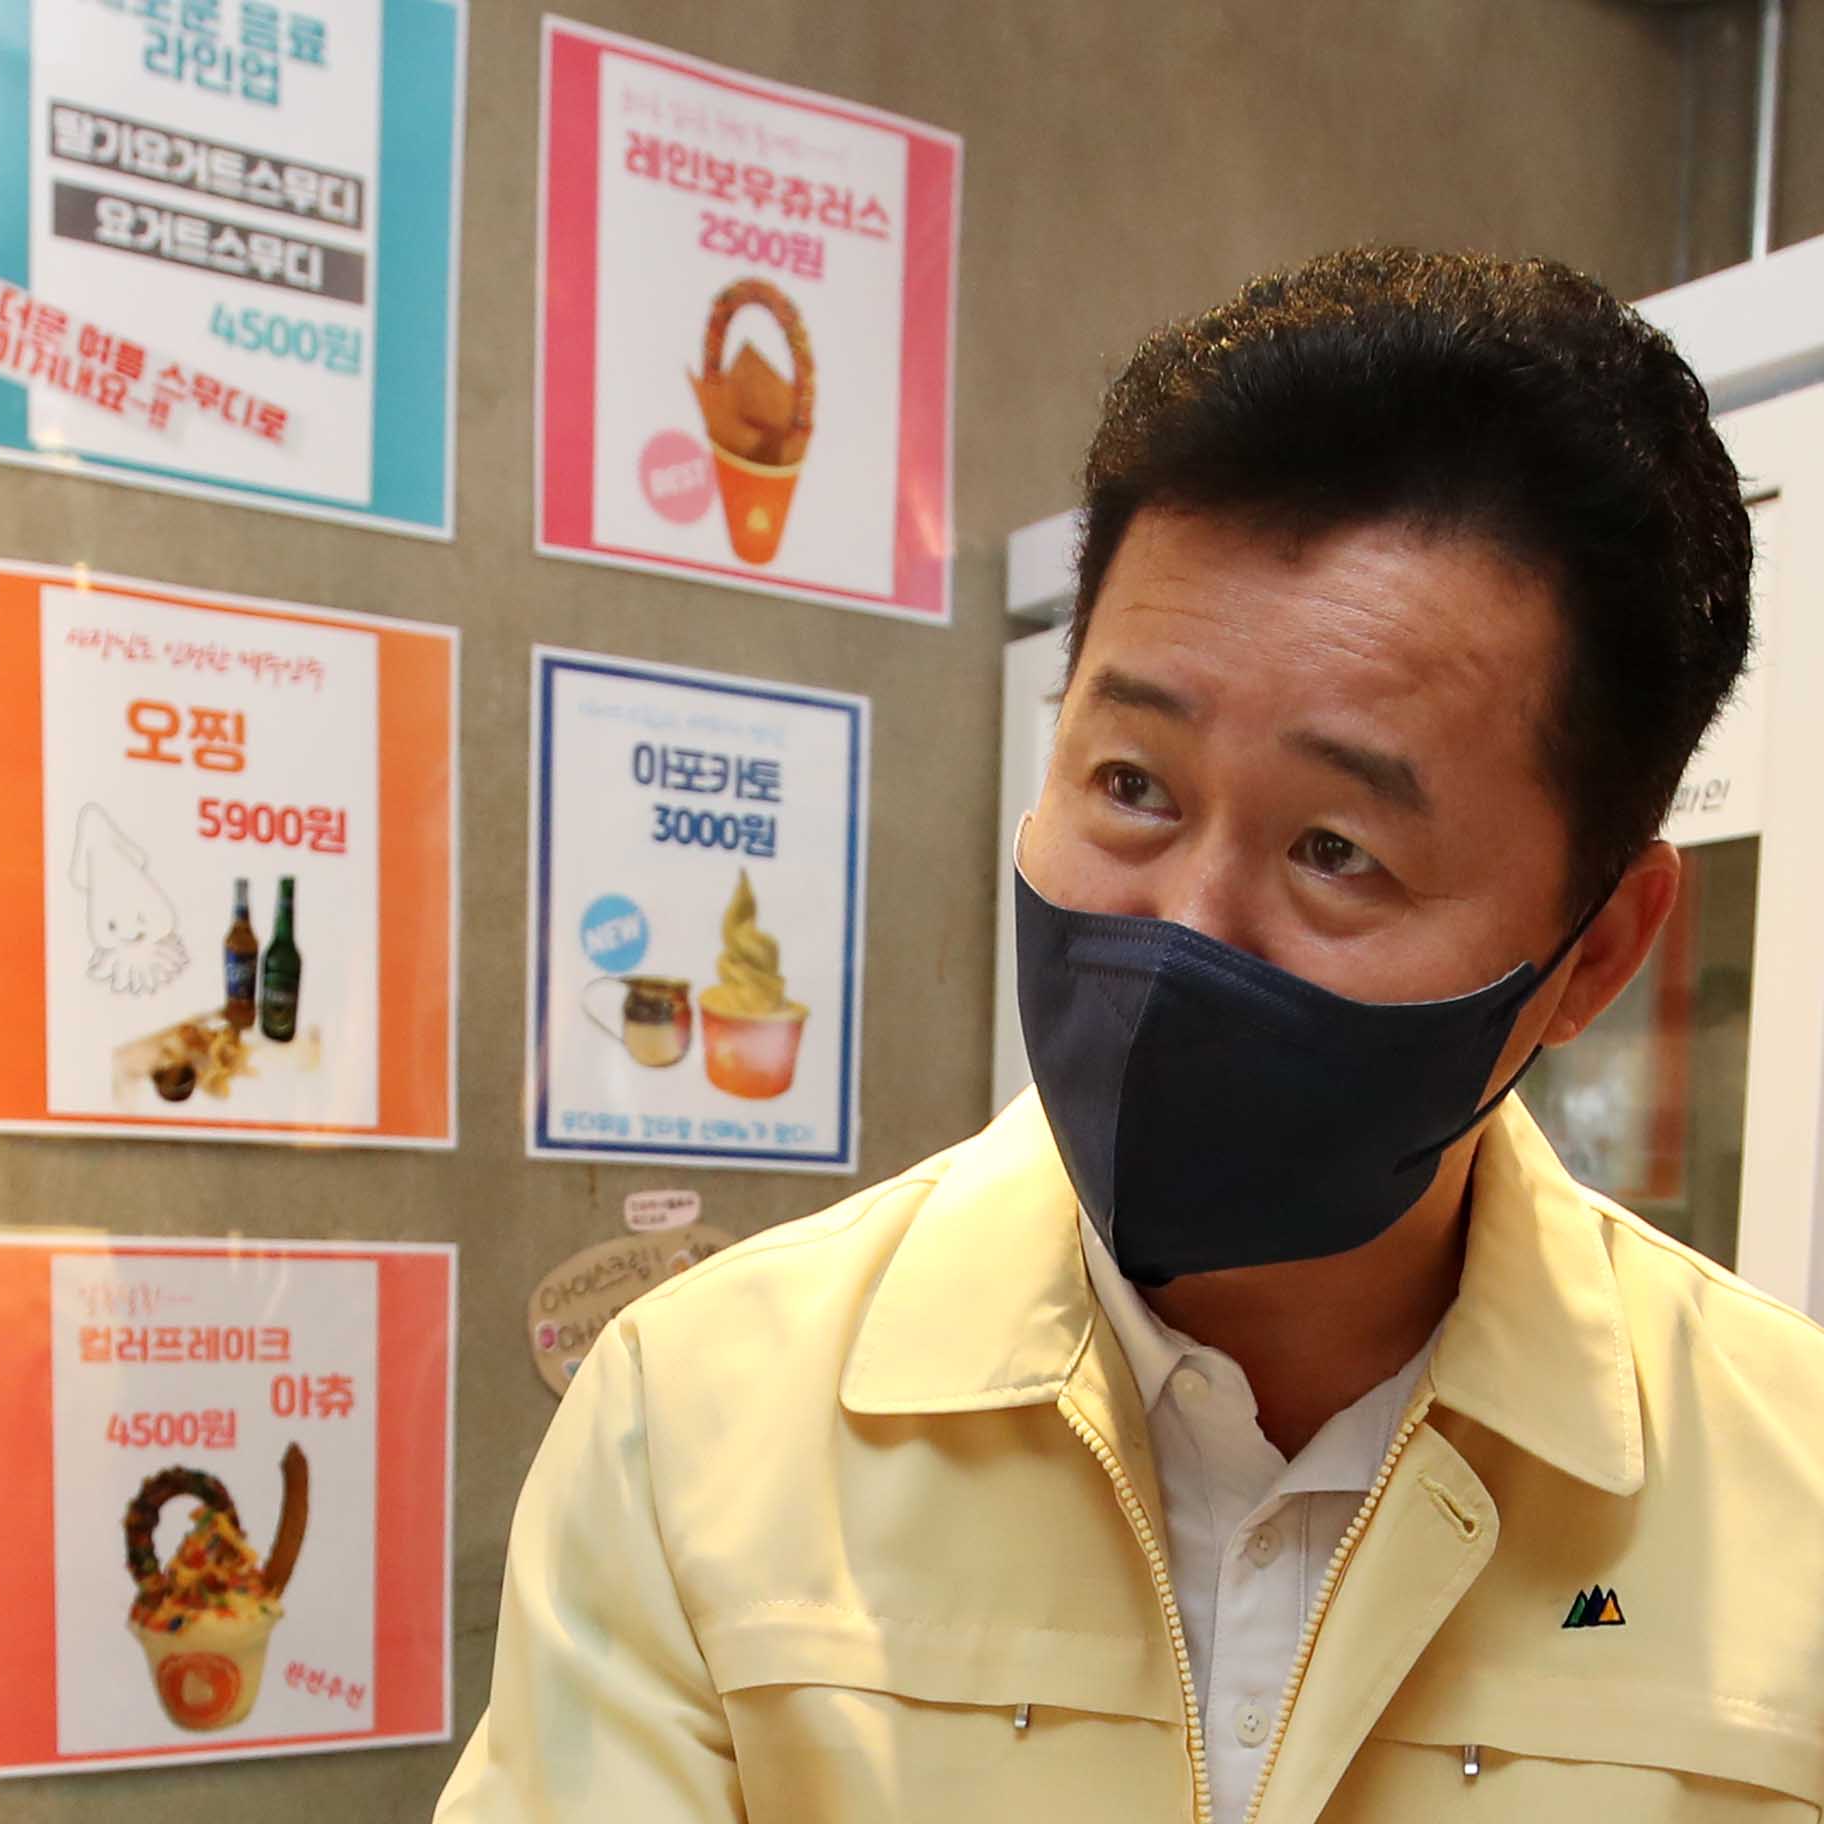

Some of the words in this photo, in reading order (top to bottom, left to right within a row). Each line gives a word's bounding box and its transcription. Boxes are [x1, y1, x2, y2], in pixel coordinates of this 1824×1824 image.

[144, 27, 280, 108] 라인업
[53, 108, 359, 224] 딸기요거트스무디
[624, 129, 891, 242] 레인보우츄러스
[96, 197, 322, 290] 요거트스무디
[698, 211, 826, 283] 2500원
[210, 301, 364, 377] 4500원
[124, 697, 248, 774] 오찡
[632, 740, 783, 804] 아포카토
[197, 795, 350, 856] 5900원
[652, 803, 777, 859] 3000원
[586, 914, 643, 957] NEW
[79, 1325, 292, 1364] 컬러프레이크
[106, 1409, 238, 1450] 4500원
[270, 1373, 356, 1421] 아츄
